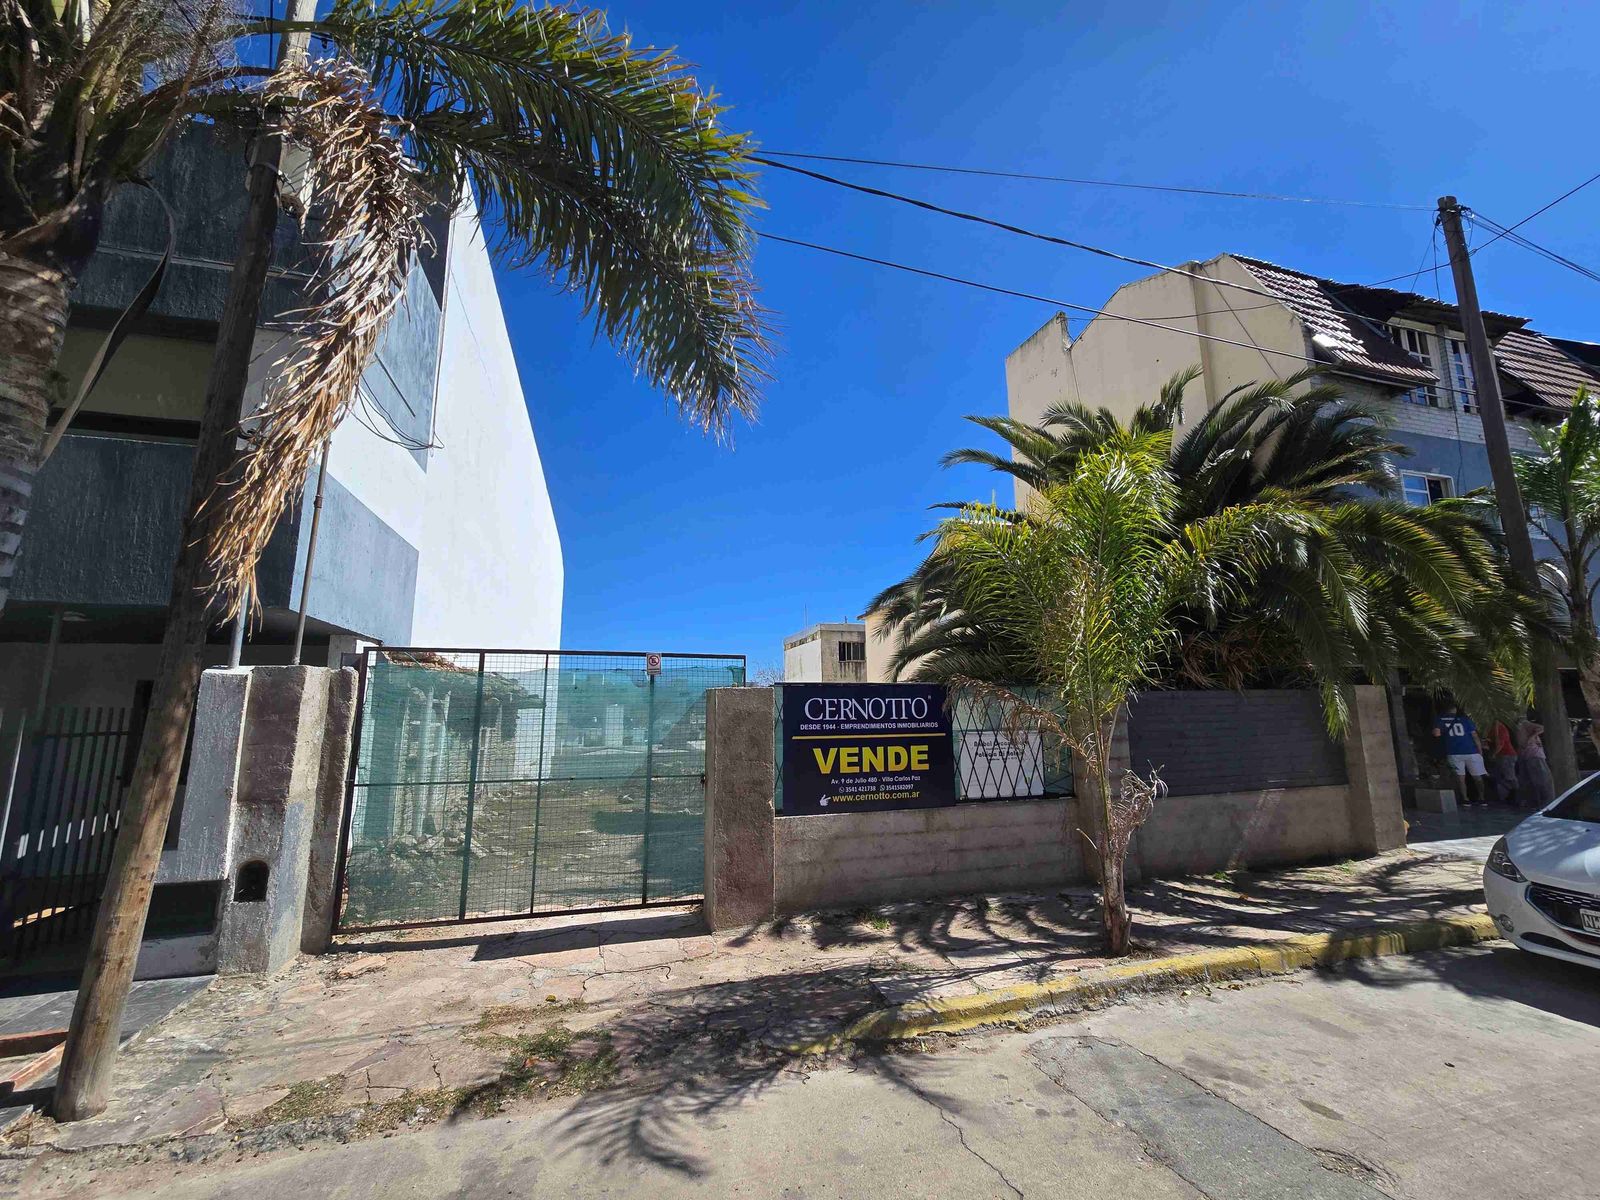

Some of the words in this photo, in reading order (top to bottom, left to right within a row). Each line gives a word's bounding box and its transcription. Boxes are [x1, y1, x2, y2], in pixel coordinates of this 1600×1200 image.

[804, 697, 928, 721] CERNOTTO
[800, 723, 821, 731] DESDE
[897, 721, 939, 729] INMOBILIARIOS
[812, 745, 930, 775] VENDE
[832, 791, 920, 803] www.cernotto.com.ar
